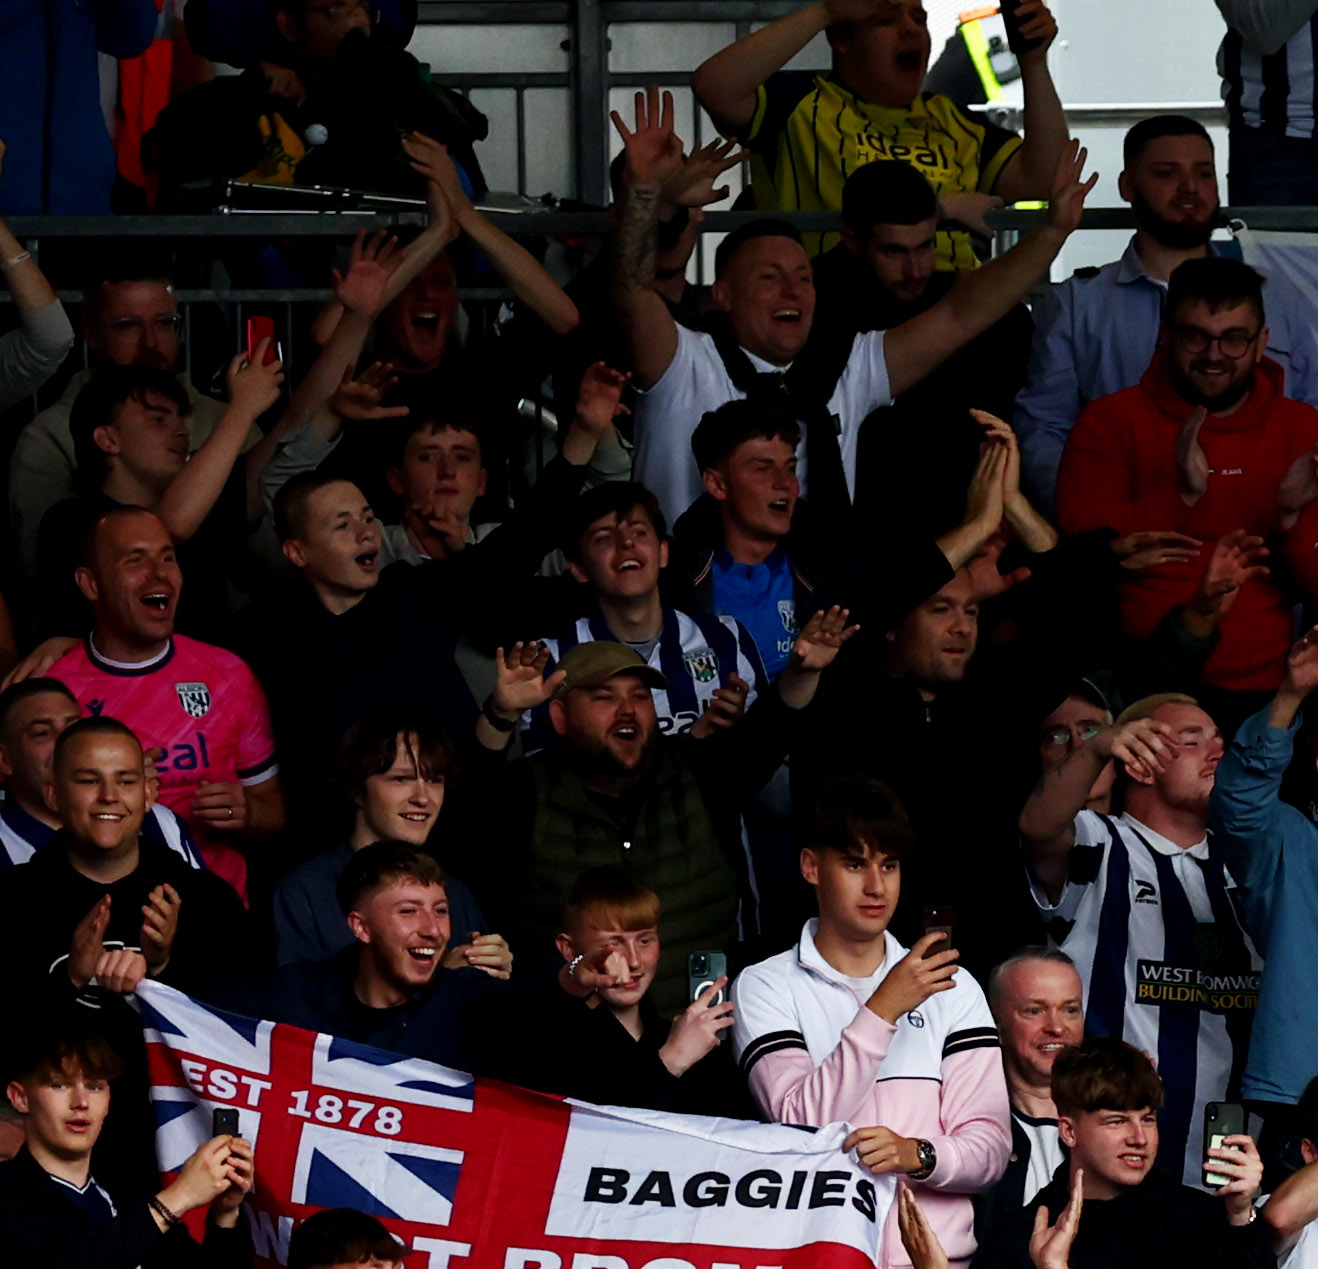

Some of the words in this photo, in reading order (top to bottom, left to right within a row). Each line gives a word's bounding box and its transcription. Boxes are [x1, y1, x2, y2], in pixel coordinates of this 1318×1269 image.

[1141, 964, 1194, 983] WEST
[1138, 983, 1207, 1003] BUILDIN
[183, 1062, 273, 1108] EST
[288, 1089, 402, 1135] 1878
[585, 1167, 876, 1220] BAGGIES
